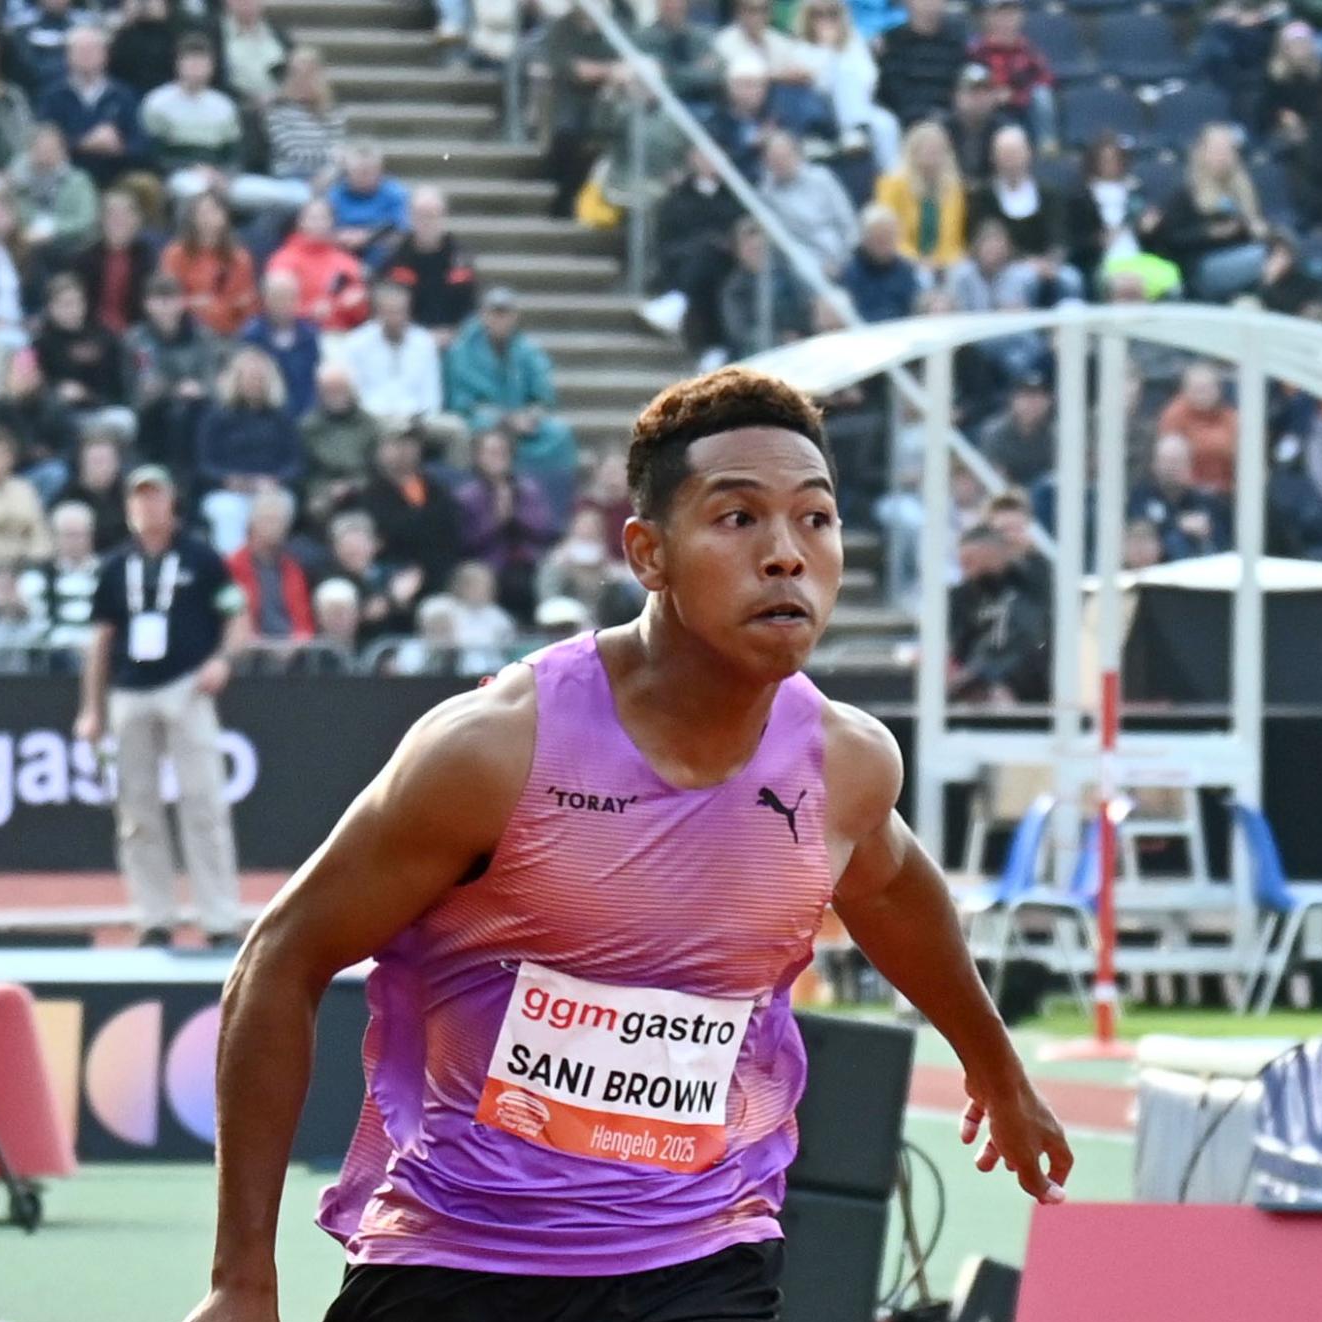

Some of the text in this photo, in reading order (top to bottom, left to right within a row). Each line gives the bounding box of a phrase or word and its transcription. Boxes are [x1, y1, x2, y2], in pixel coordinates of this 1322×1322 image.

[507, 1044, 717, 1113] SANI BROWN
[590, 1125, 697, 1163] Hengelo 2025
